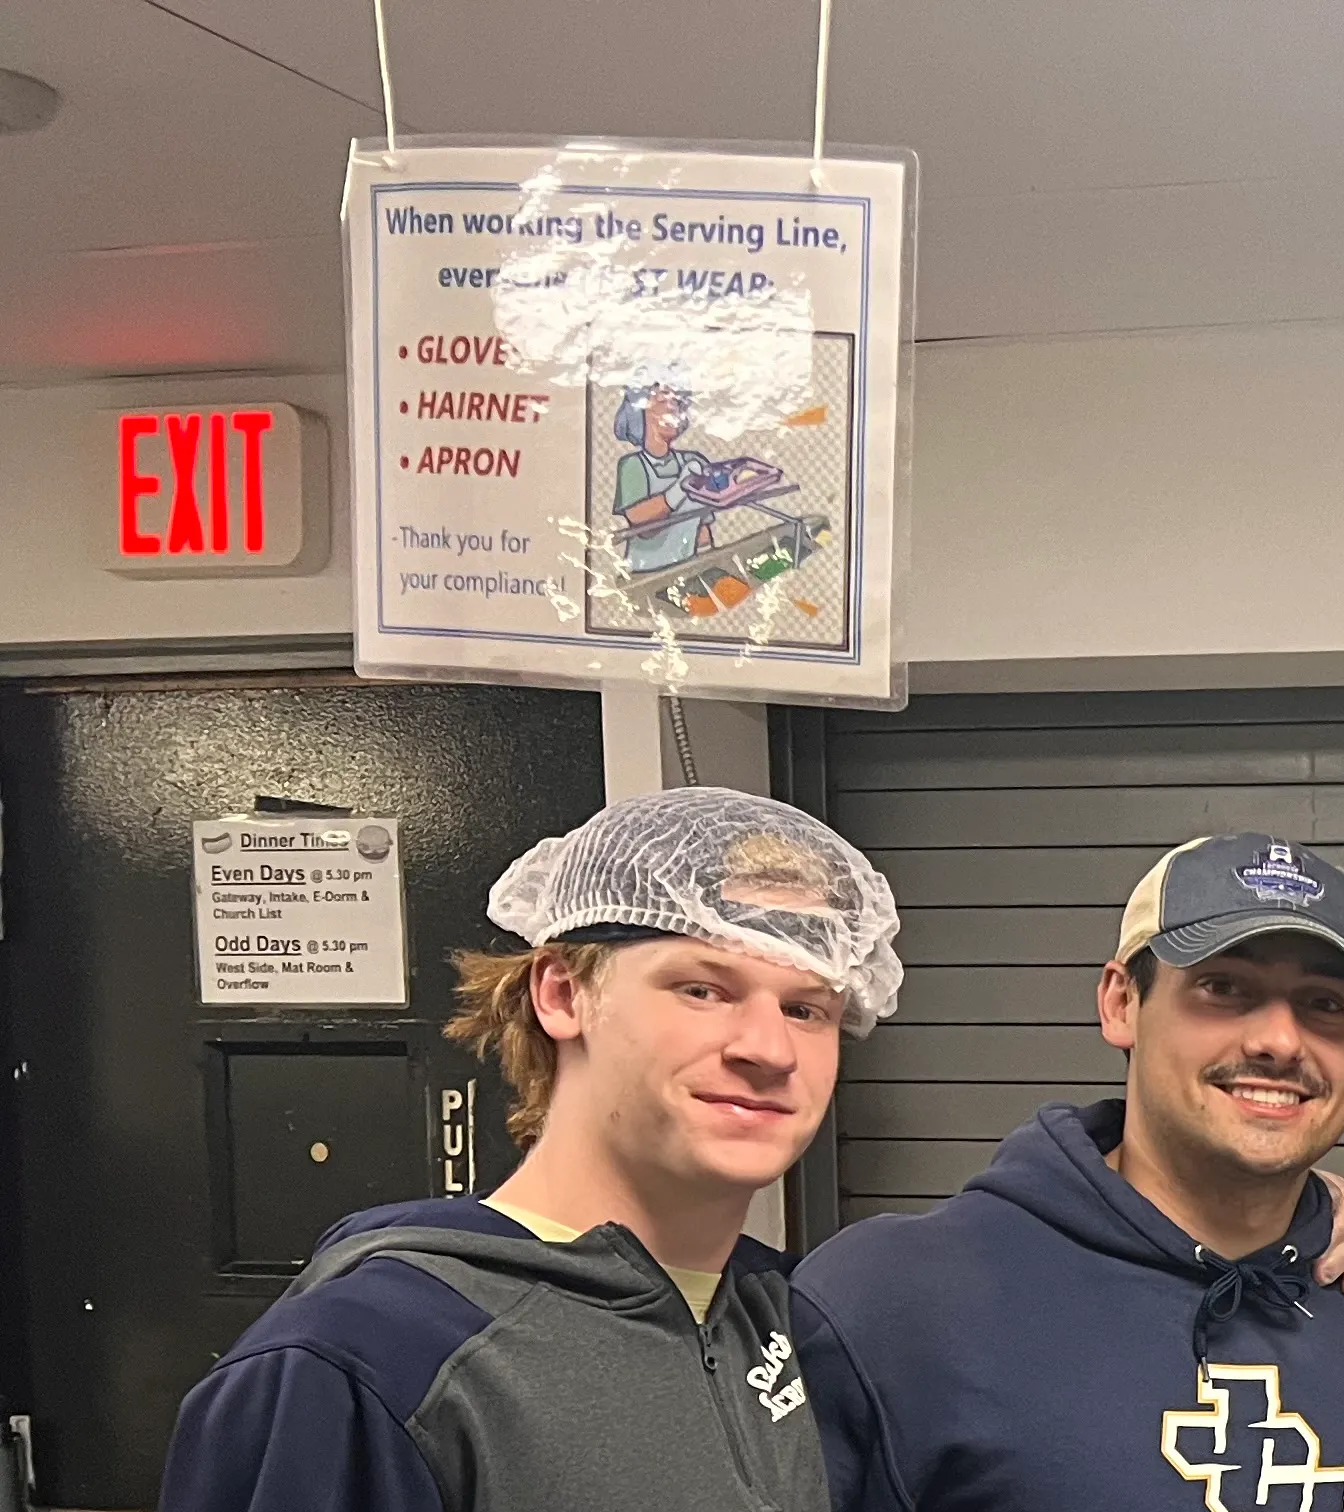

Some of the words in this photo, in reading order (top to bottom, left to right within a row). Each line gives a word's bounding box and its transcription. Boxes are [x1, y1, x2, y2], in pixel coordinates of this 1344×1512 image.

[385, 206, 453, 234] When
[595, 210, 641, 240] the
[652, 212, 764, 253] Serving
[776, 216, 847, 254] Line,
[417, 335, 508, 366] GLOVE
[417, 390, 550, 423] HAIRNET
[416, 446, 521, 478] APRON
[118, 410, 273, 556] EXIT
[456, 533, 493, 556] you
[501, 528, 531, 553] for
[400, 570, 438, 595] your
[443, 570, 566, 599] complianc!
[240, 832, 295, 848] Dinner
[211, 865, 254, 882] Even
[260, 864, 305, 884] Days
[310, 869, 323, 883] @
[353, 871, 373, 883] pm
[361, 890, 370, 902] &
[213, 908, 255, 920] Church
[259, 907, 283, 919] List
[214, 935, 251, 952] Odd
[256, 935, 301, 955] Days
[306, 940, 320, 954] @
[349, 941, 369, 954] pm
[215, 962, 245, 974] West
[282, 961, 303, 973] Mat
[306, 961, 342, 973] Room
[216, 978, 270, 990] Overflow
[442, 1089, 463, 1198] PUL
